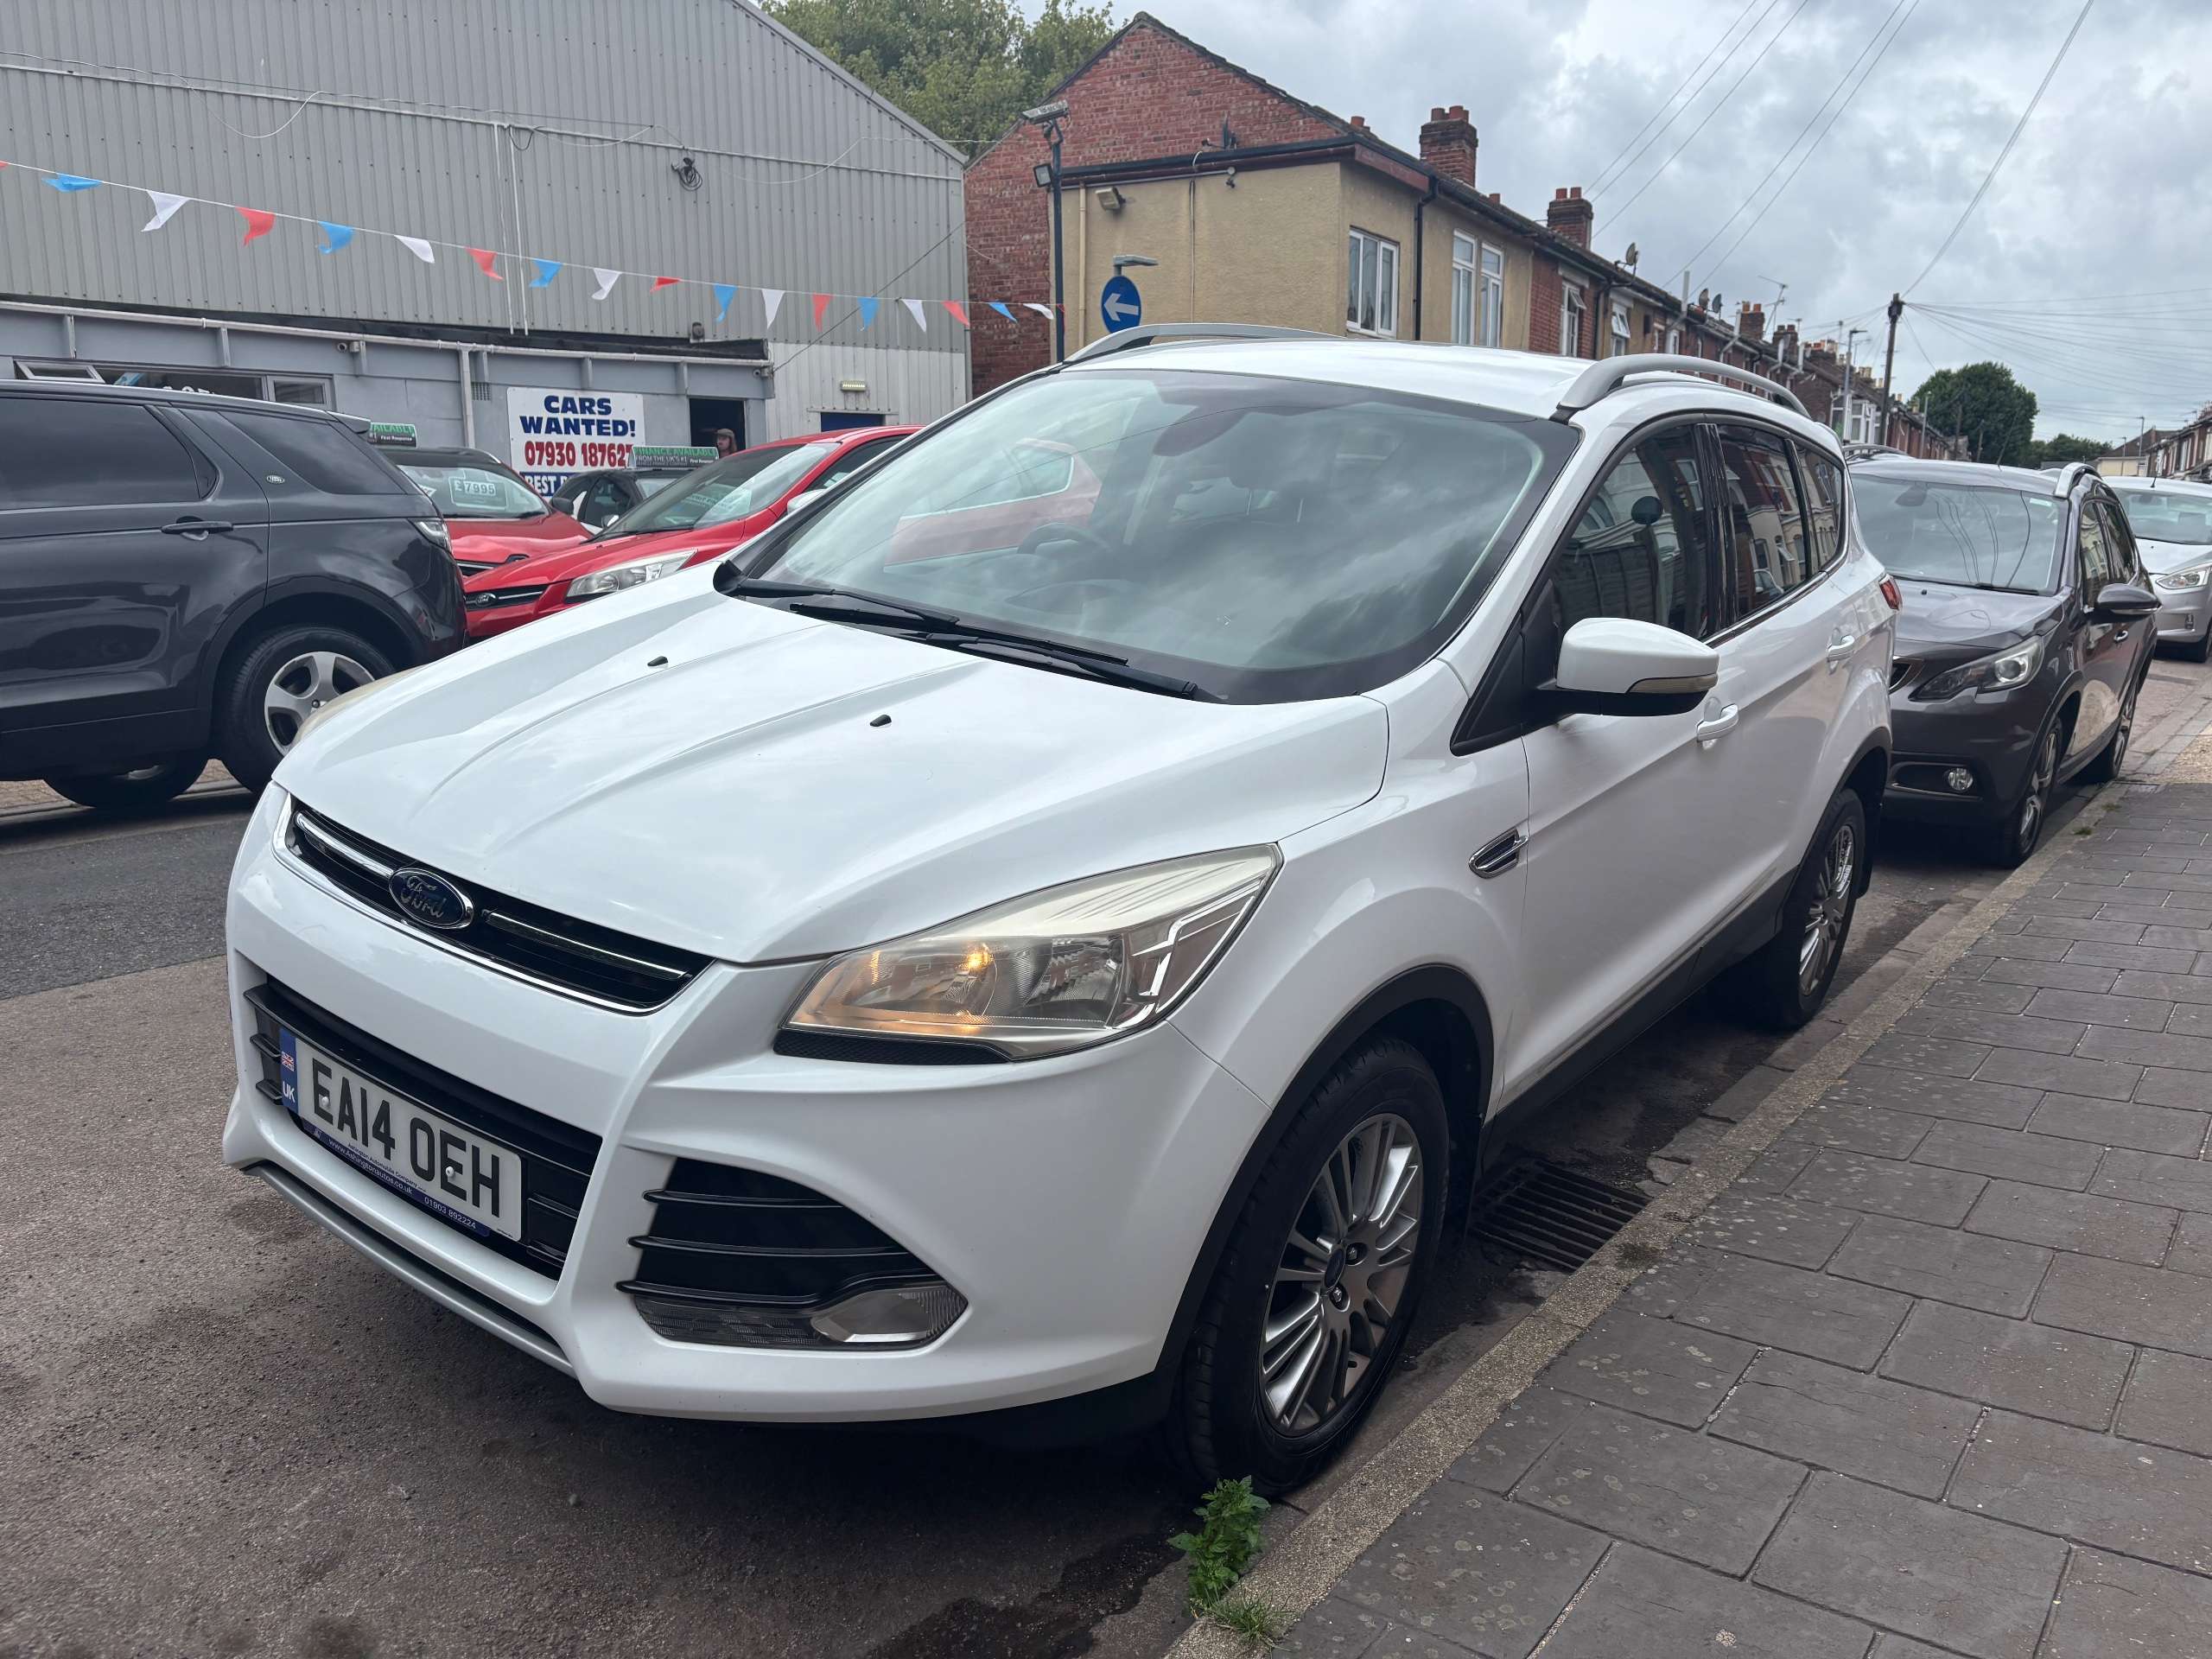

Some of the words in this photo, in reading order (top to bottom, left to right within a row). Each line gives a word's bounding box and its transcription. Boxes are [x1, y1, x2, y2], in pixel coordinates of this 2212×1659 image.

[543, 395, 613, 416] CARS
[519, 416, 636, 437] WANTED!
[524, 441, 576, 467] 07930
[582, 442, 633, 468] 187627
[400, 875, 448, 918] Ford
[283, 1080, 296, 1103] UK
[312, 1058, 396, 1161] EA14
[410, 1116, 500, 1218] OEH
[423, 1196, 448, 1214] 01903
